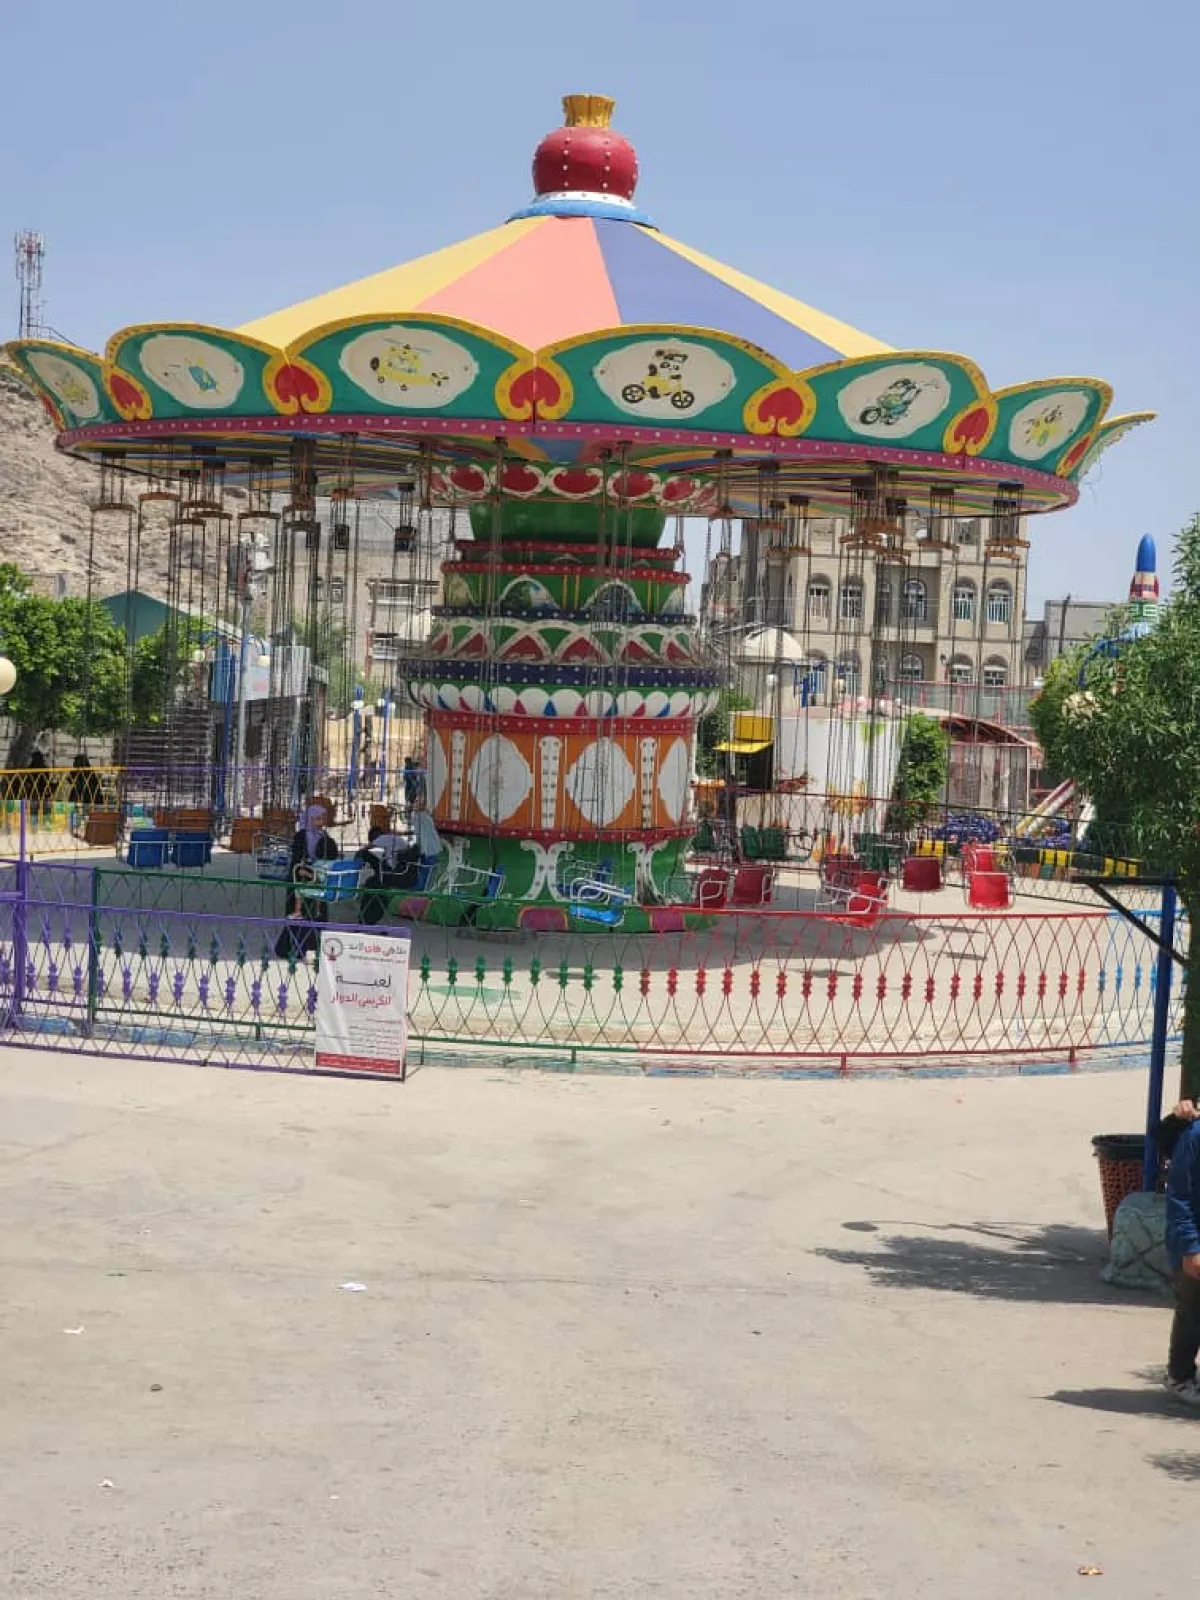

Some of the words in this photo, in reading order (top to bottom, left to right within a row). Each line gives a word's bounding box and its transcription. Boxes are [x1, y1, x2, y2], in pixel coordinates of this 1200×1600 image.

[335, 969, 392, 989] لعبة
[329, 990, 359, 1005] الدوار
[358, 993, 393, 1010] الكرسي
